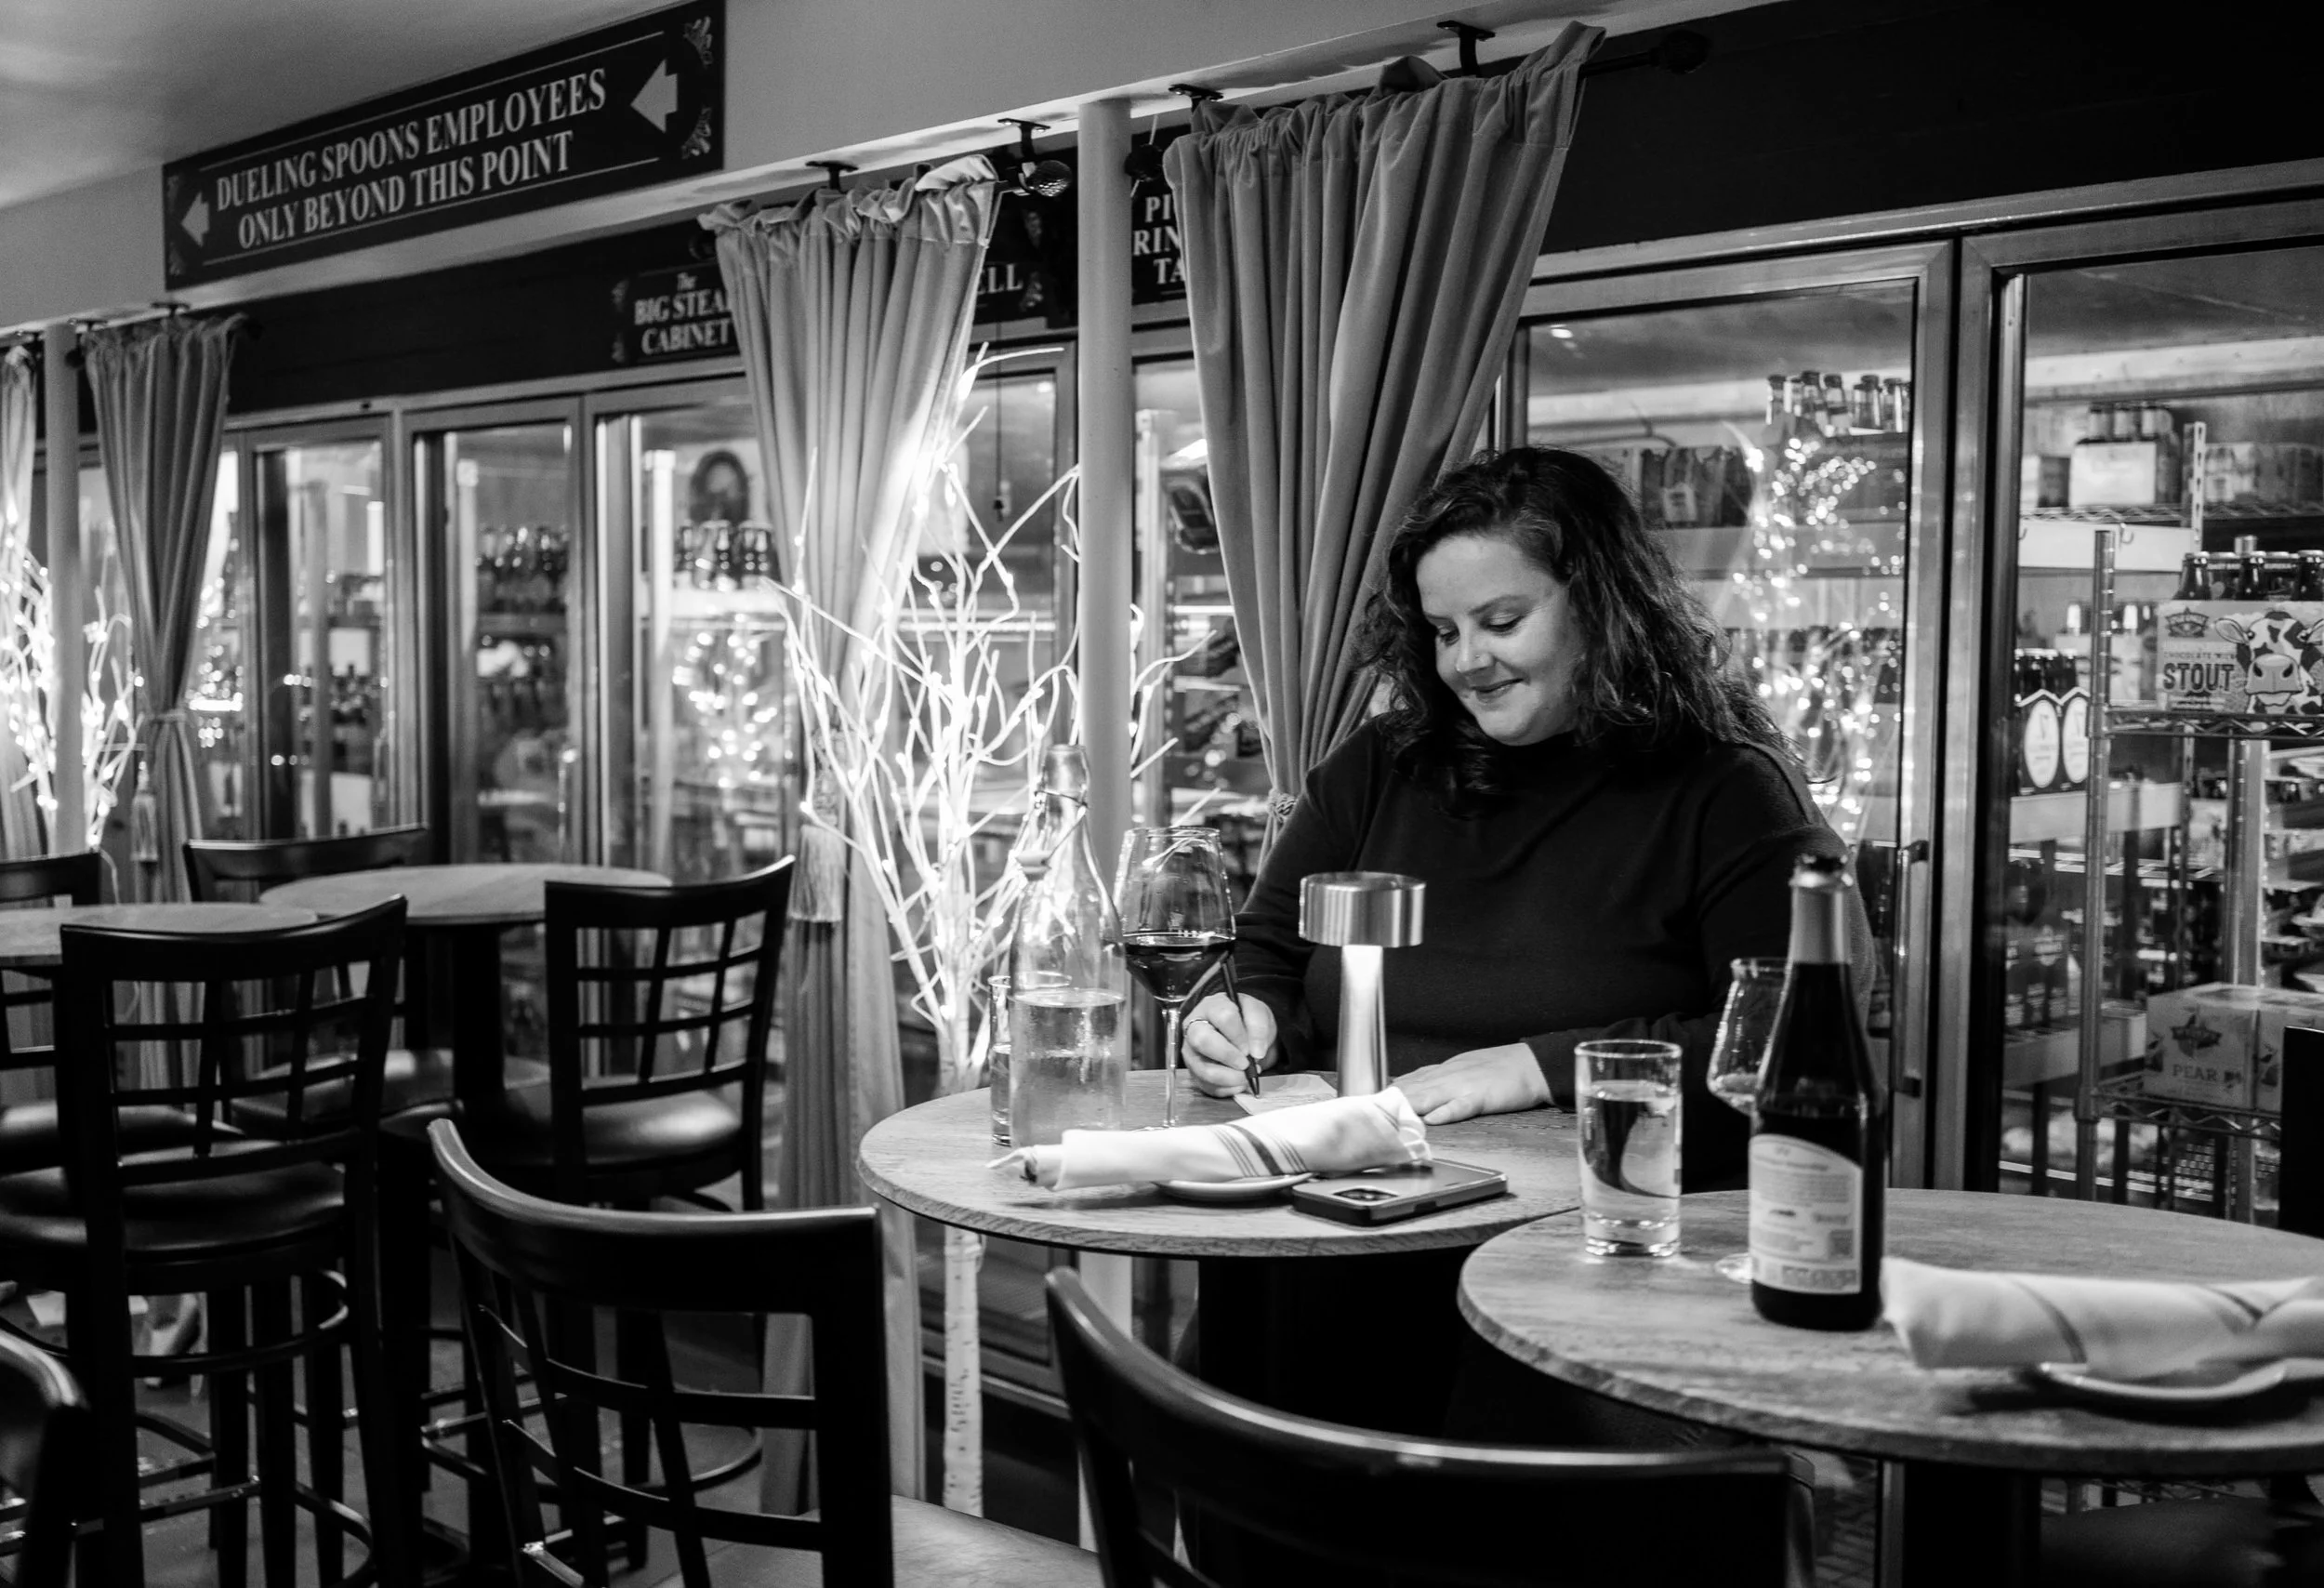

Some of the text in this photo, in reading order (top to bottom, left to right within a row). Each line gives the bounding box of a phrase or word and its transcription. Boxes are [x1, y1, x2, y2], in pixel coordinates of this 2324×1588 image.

[216, 68, 606, 212] DUELING SPOONS EMPLOYEES
[238, 130, 574, 249] ONLY BEYOND THIS POINT
[634, 295, 670, 325] BIG
[640, 317, 732, 355] CABINET
[2163, 663, 2234, 691] STOUT
[2172, 1064, 2218, 1081] PEAR
